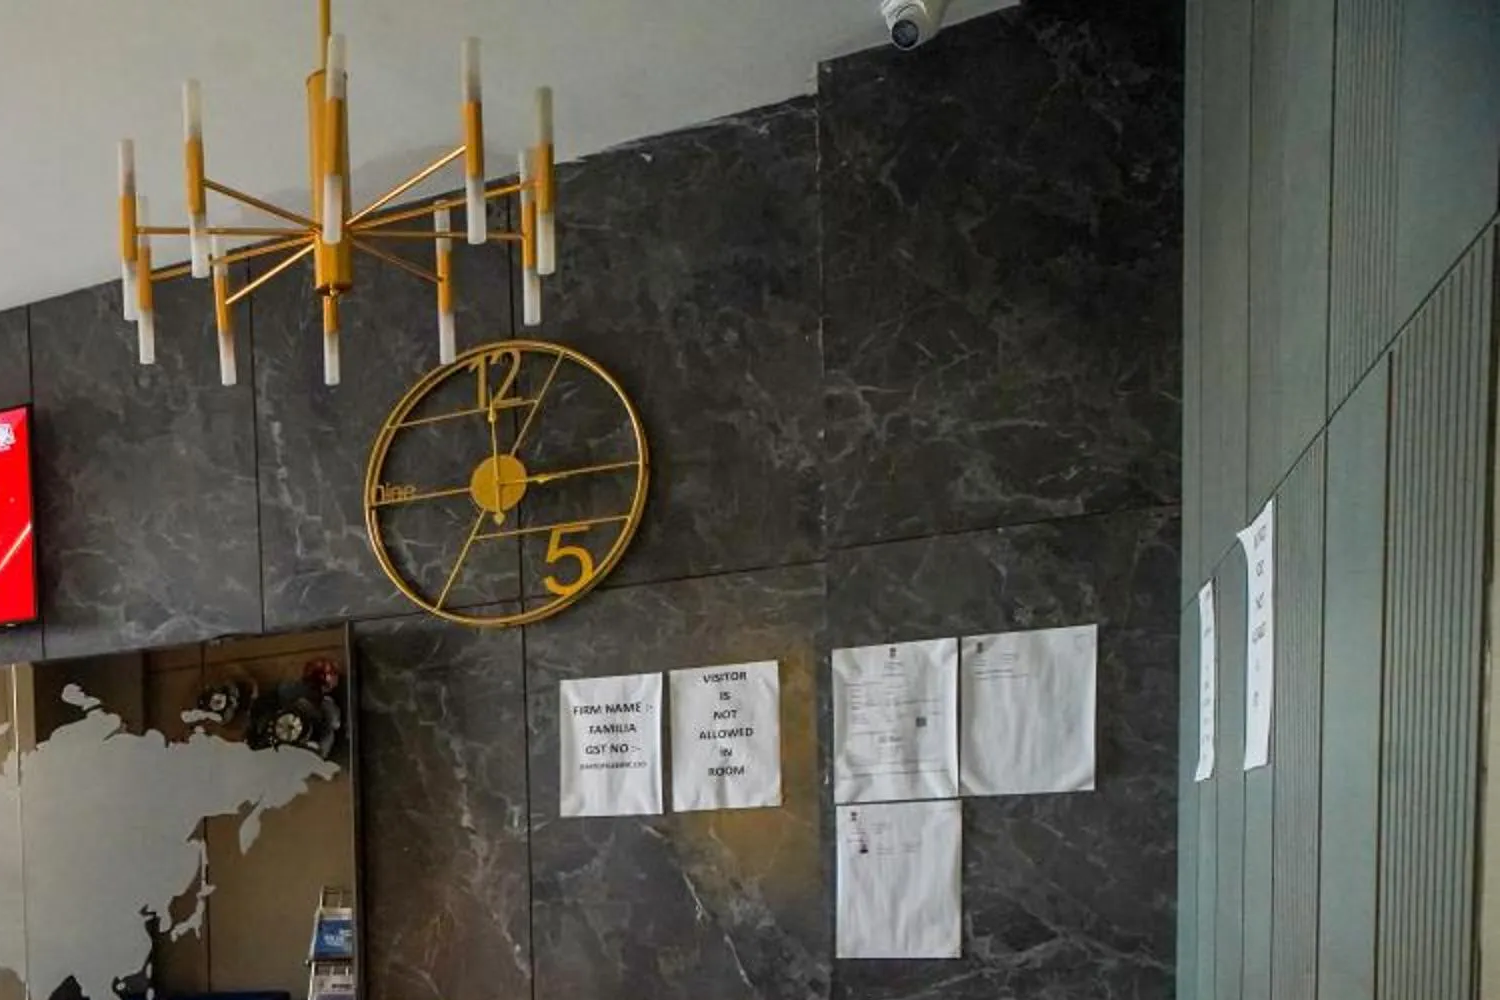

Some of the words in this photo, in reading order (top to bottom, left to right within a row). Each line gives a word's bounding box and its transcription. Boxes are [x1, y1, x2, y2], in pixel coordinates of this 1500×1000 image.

[469, 350, 524, 408] 12
[543, 524, 596, 596] 5
[703, 671, 747, 683] VISITOR
[719, 691, 731, 701] IS
[573, 705, 602, 715] FIRM
[605, 701, 642, 713] NAME
[713, 709, 738, 720] NOT
[699, 727, 754, 740] ALLOWED
[585, 744, 606, 755] GST
[610, 743, 629, 754] NO
[719, 747, 733, 757] IN
[708, 765, 745, 776] ROOM
